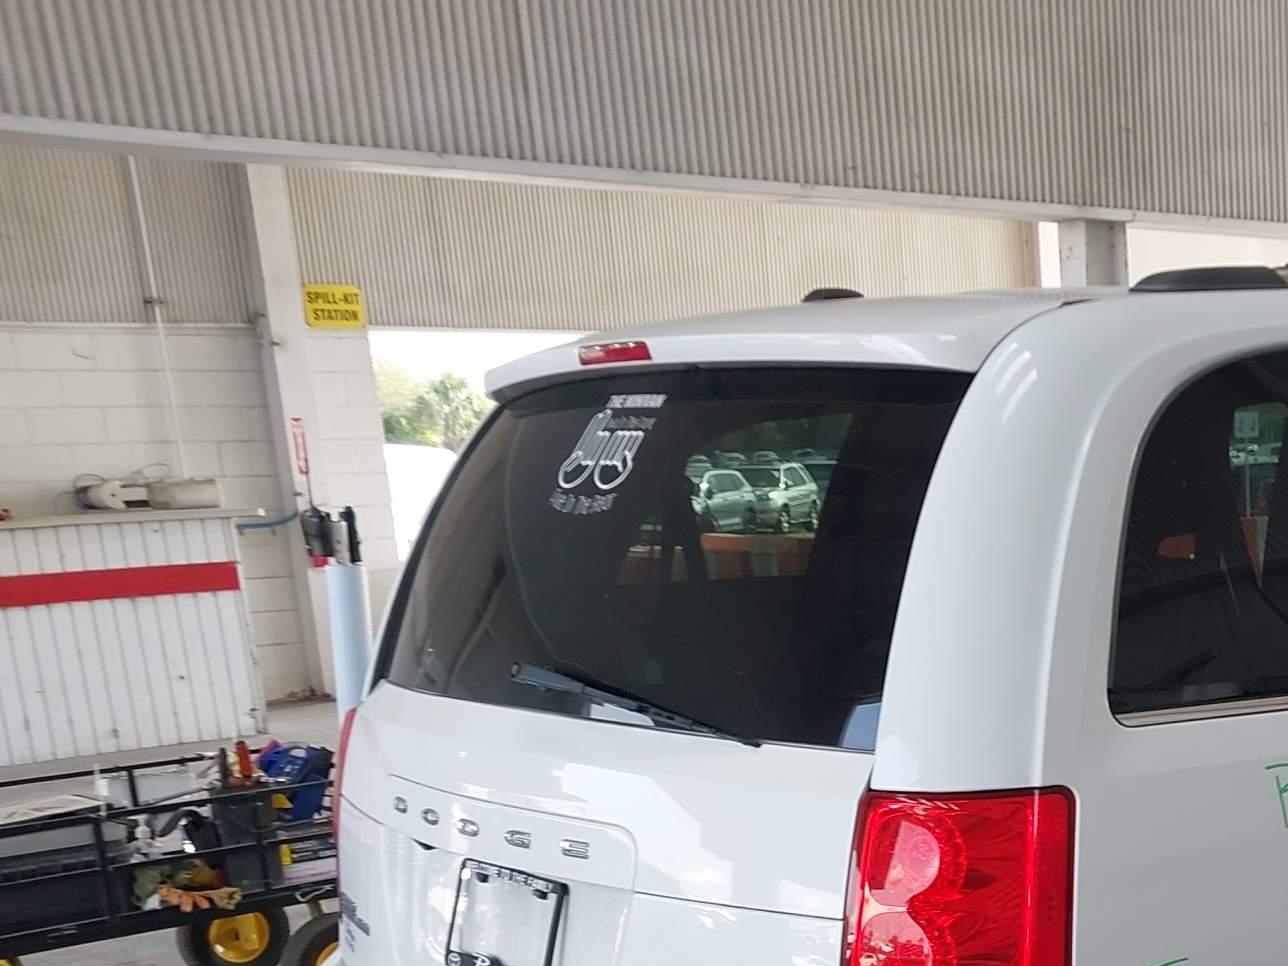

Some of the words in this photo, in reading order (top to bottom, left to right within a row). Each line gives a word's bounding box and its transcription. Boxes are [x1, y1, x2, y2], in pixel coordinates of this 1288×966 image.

[306, 292, 360, 305] SPILL-KIT
[313, 309, 360, 321] STATION
[393, 796, 590, 860] DODGE
